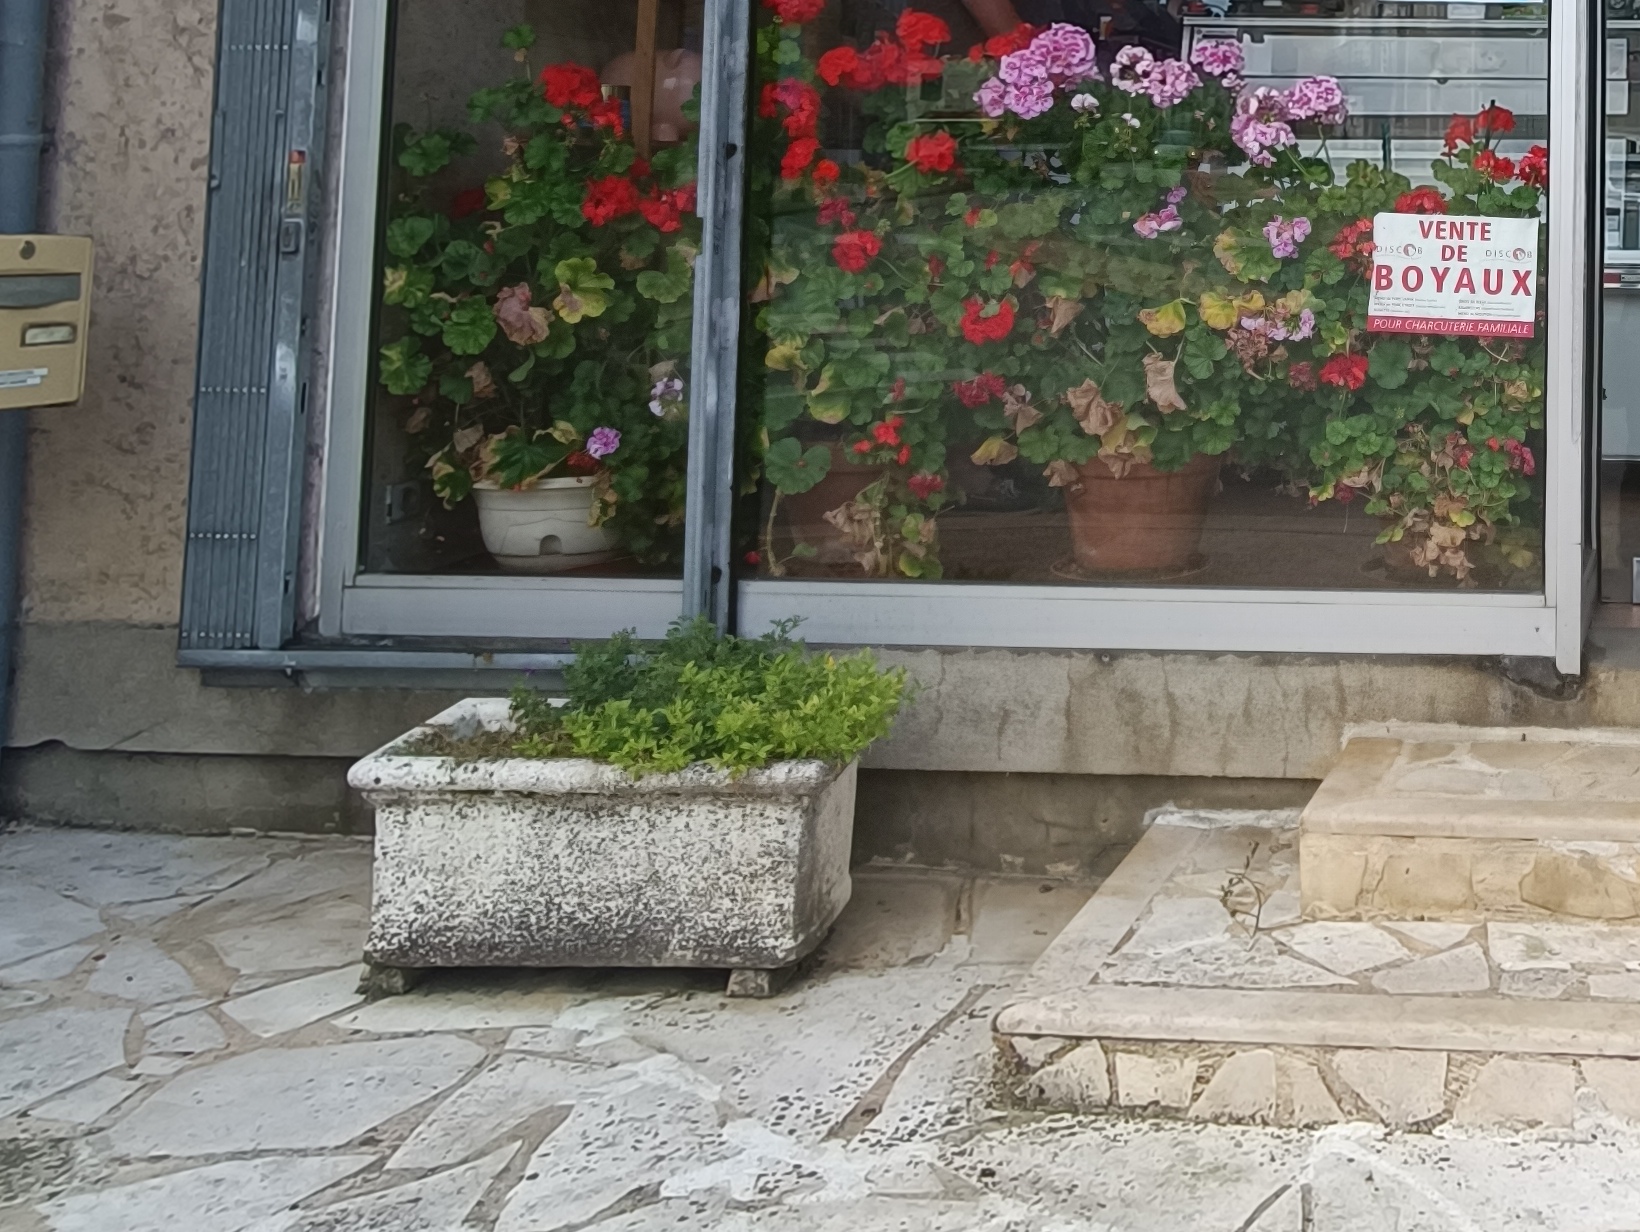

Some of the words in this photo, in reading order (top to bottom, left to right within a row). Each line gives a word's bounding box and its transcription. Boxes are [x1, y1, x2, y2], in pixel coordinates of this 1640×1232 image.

[1418, 219, 1492, 241] VENTE
[1441, 244, 1468, 263] DE
[1374, 264, 1533, 297] BOYAUX
[1373, 318, 1402, 329] POUR
[1405, 319, 1475, 333] CHARCUTERIE
[1477, 322, 1530, 335] FAMILIALE
